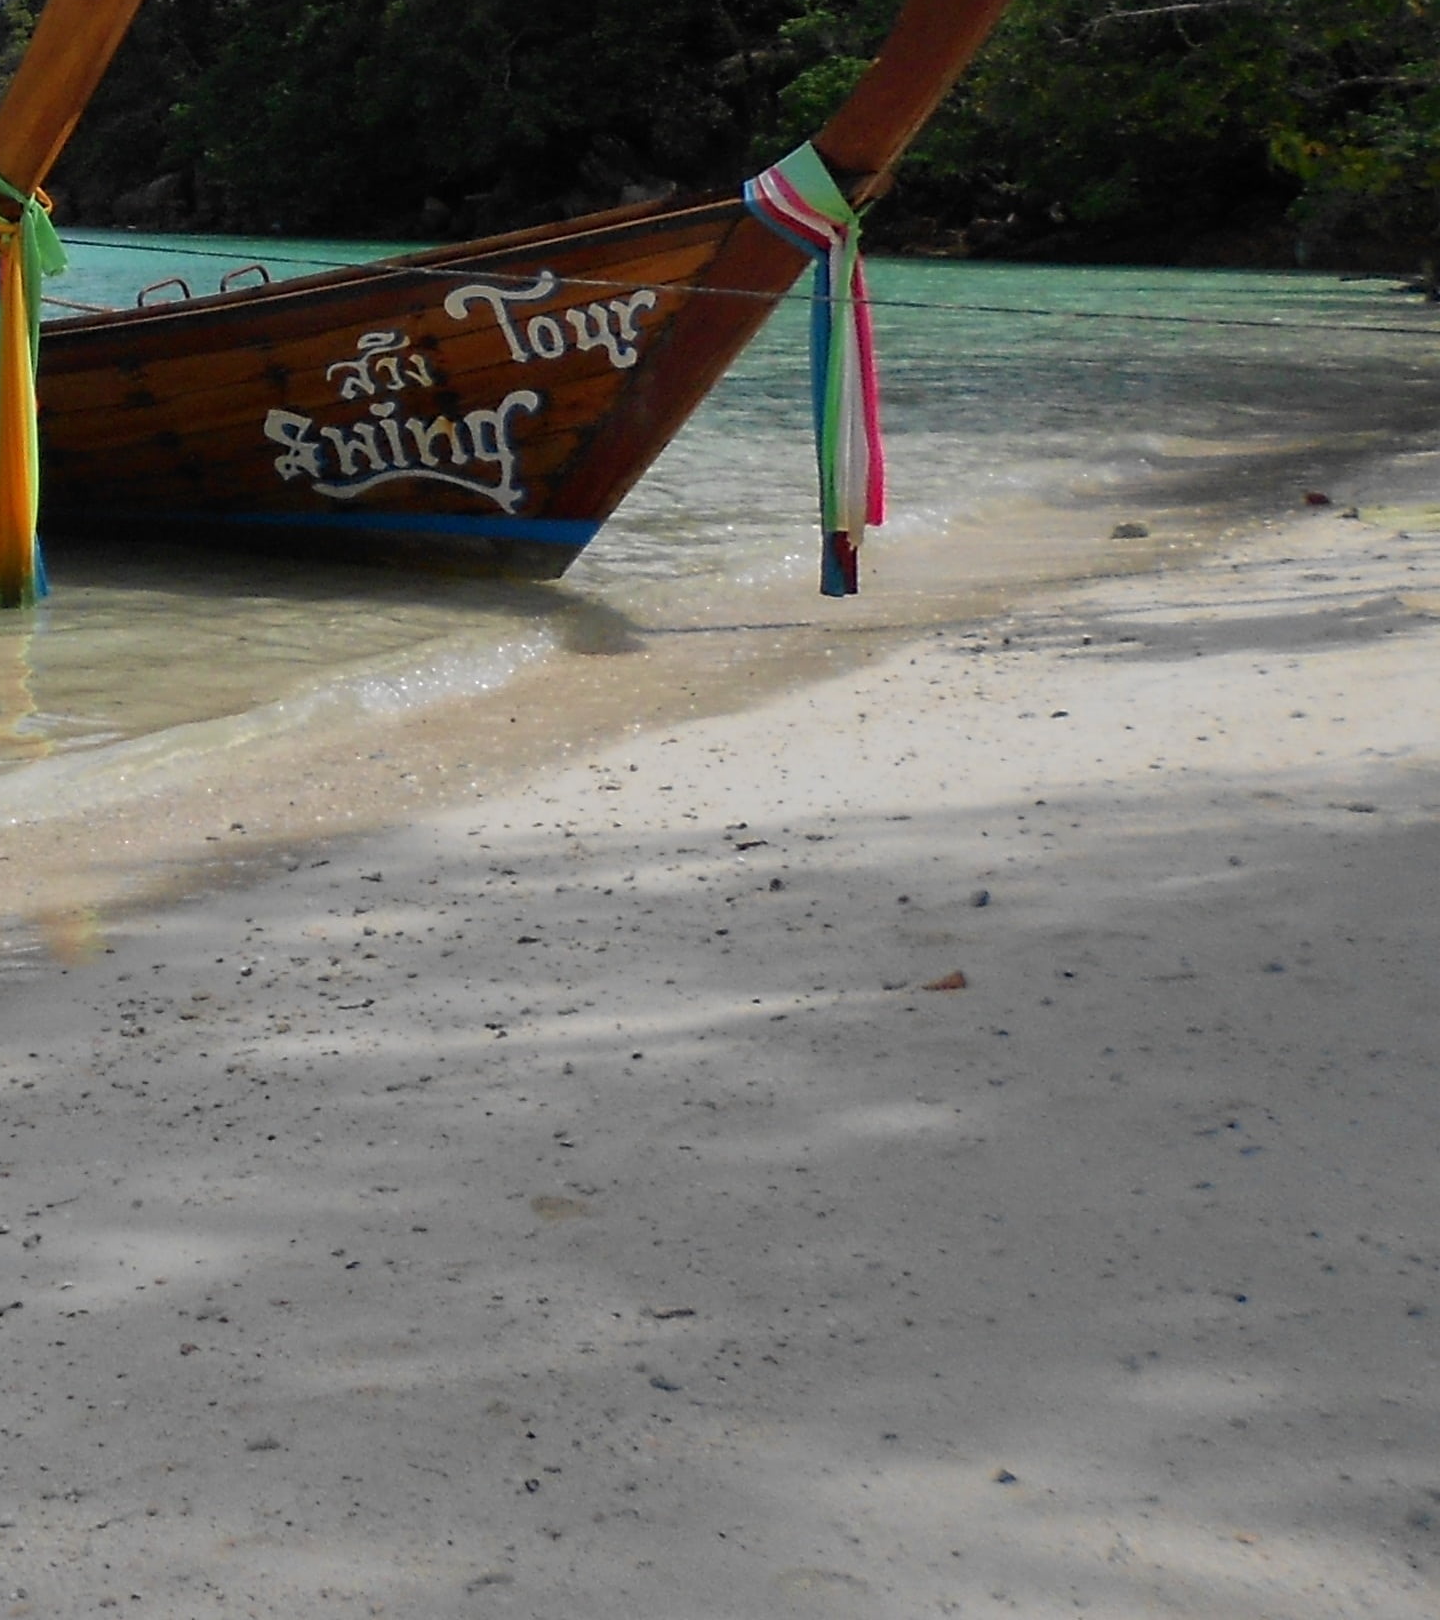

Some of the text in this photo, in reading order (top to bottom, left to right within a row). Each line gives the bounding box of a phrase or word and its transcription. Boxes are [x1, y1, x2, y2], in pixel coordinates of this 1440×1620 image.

[326, 332, 433, 400] สวิง
[443, 271, 657, 369] Tour
[263, 390, 539, 514] Swing
